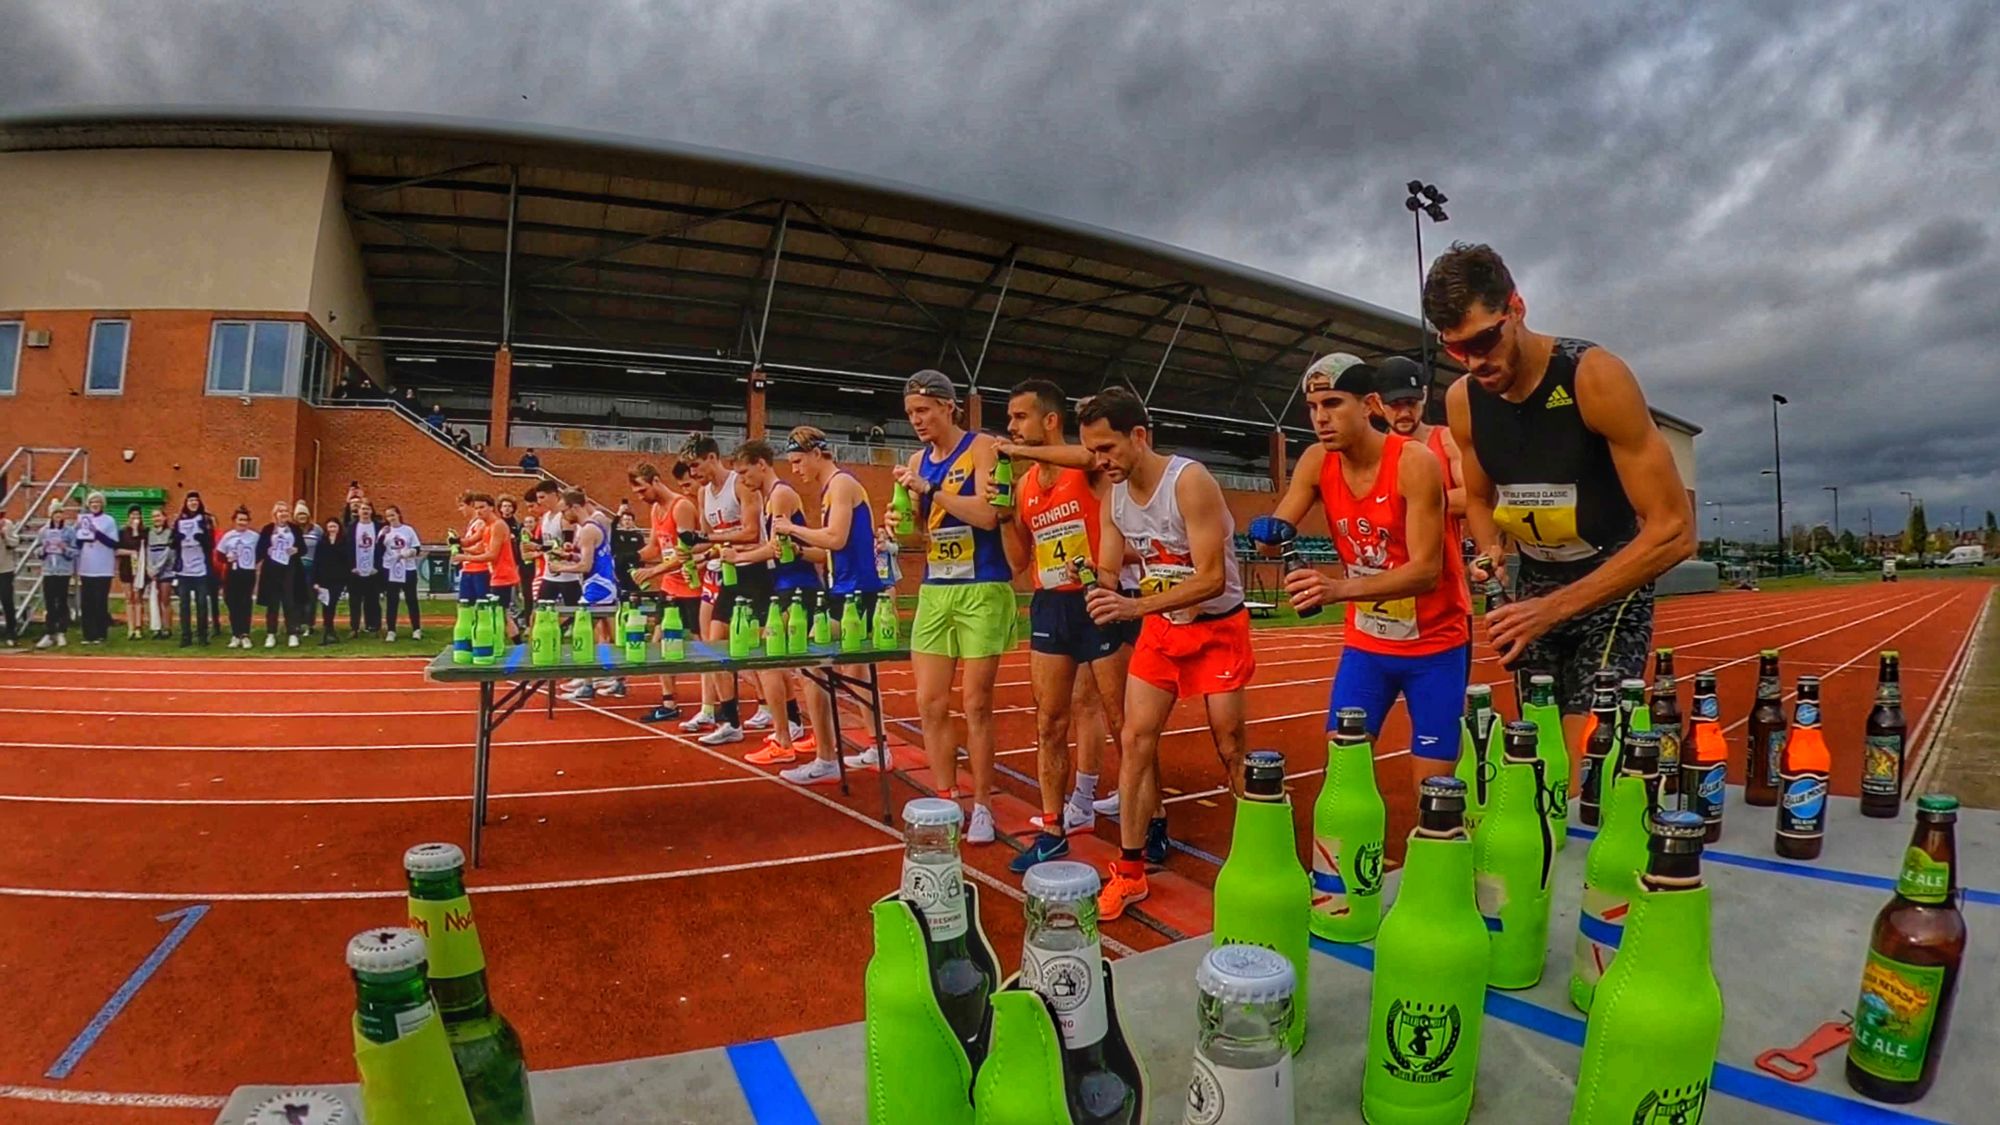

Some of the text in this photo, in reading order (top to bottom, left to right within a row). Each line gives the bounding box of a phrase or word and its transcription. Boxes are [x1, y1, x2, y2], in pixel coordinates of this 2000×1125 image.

[1031, 500, 1080, 528] CANADA
[1522, 511, 1543, 542] 1
[937, 541, 963, 560] 50
[1053, 539, 1067, 562] 4
[1915, 874, 1943, 887] ALE
[927, 914, 962, 925] FRESHING
[44, 904, 212, 1079] 1
[1872, 1038, 1909, 1059] ALE
